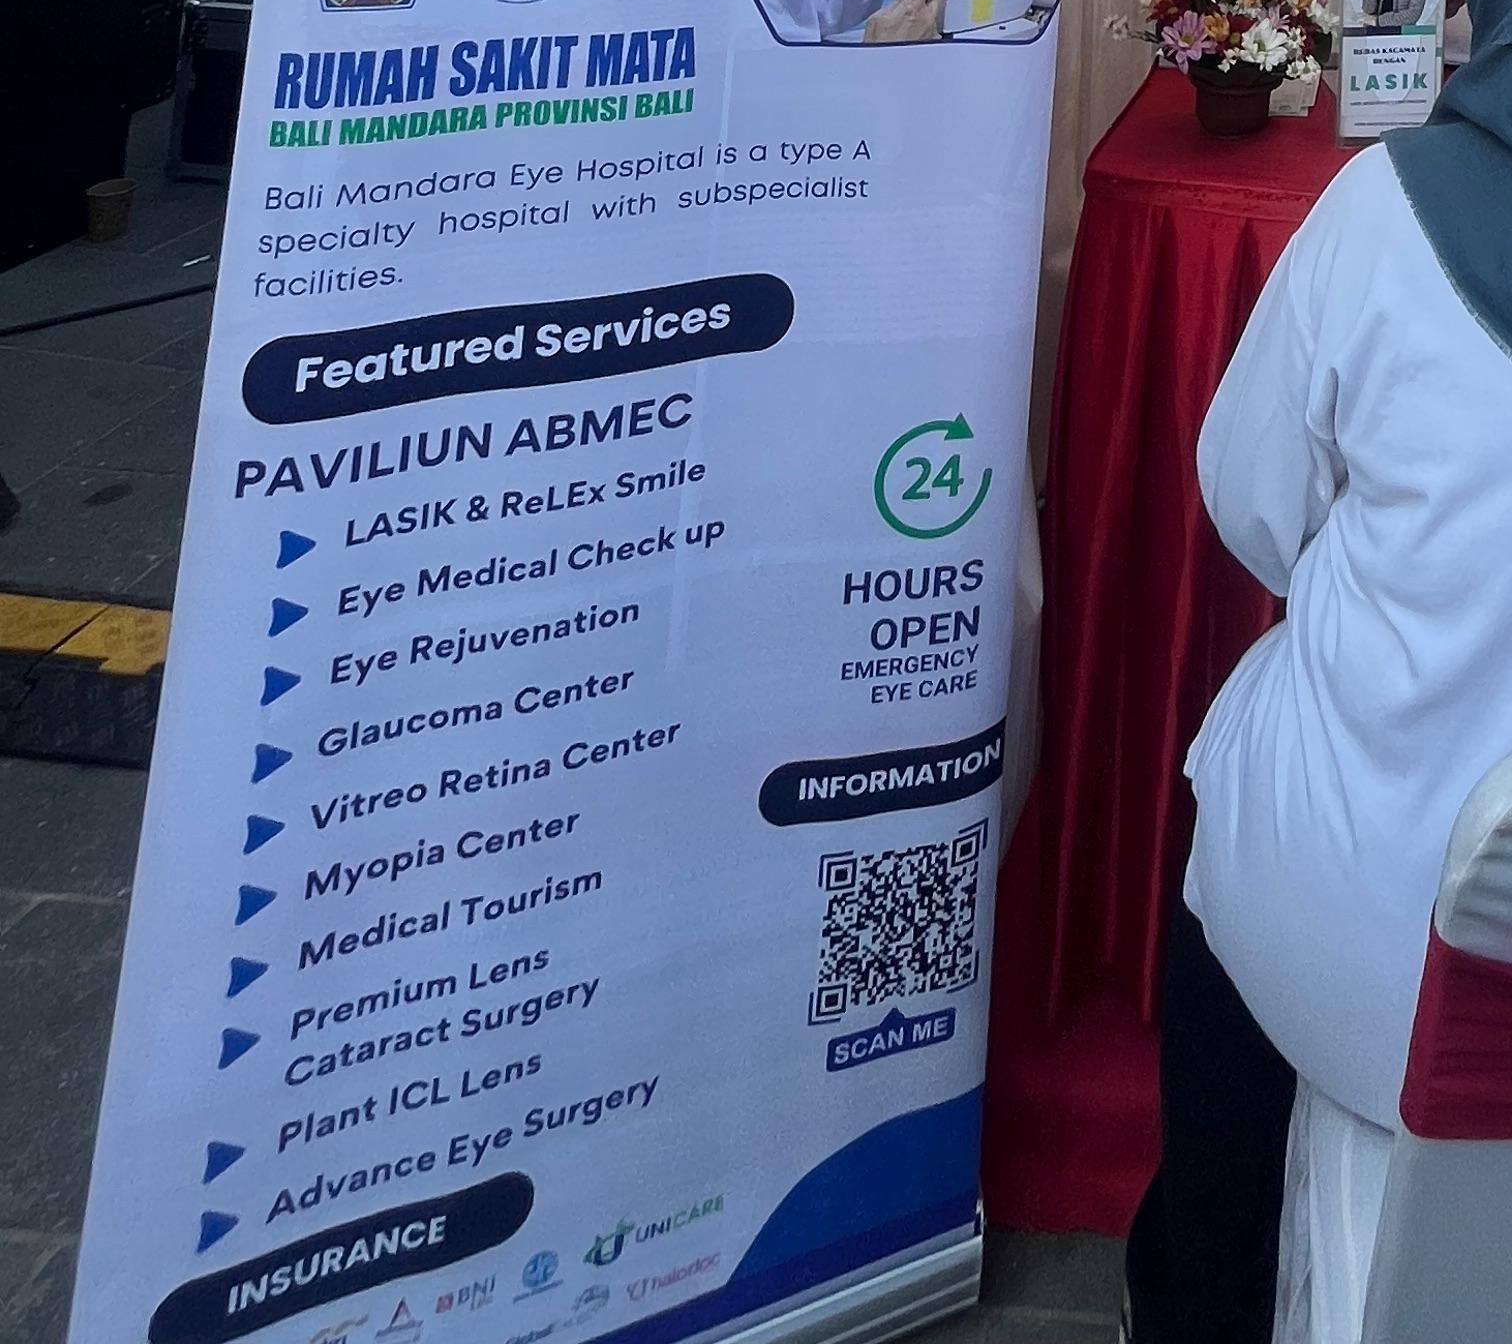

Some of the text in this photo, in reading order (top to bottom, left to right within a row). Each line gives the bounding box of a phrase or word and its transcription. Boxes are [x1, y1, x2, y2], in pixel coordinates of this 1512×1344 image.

[274, 27, 697, 110] RUMAH SAKIT MATA
[1350, 73, 1428, 91] LASIK
[269, 87, 695, 148] BALI MANDARA PROVINSI BALI
[257, 175, 870, 259] specialty hospital with subspecialist
[265, 138, 873, 212] Bali Mandara Eye Hospital is a type A
[253, 265, 404, 298] facilities.
[294, 300, 733, 395] Featured Services
[234, 392, 694, 500] PAVILIUN ABMEC
[902, 454, 964, 501] 24
[344, 458, 707, 548] LASIK & ReLEx Smile
[337, 518, 726, 619] Eye Medical Check up
[843, 558, 985, 606] HOURS
[329, 600, 640, 688] Eye Rejuvenation
[840, 643, 979, 681] EMERGENCY
[870, 605, 981, 651] OPEN
[317, 667, 635, 759] Glaucoma Center
[870, 669, 978, 704] EYE CARE
[310, 721, 682, 831] Vitreo Retina Center
[798, 738, 1001, 801] INFORMATION
[304, 811, 581, 901] Myopia Center
[297, 869, 603, 972] Medical Tourism
[284, 976, 601, 1087] Cataract Surgery
[289, 946, 551, 1041] Premium Lens
[833, 1015, 950, 1064] SCAN ME
[277, 1051, 543, 1155] Plant ICL Lens
[265, 1074, 661, 1225] Advance Eye Surgery
[635, 1192, 725, 1243] UNICARE
[227, 1215, 449, 1316] INSURANCE
